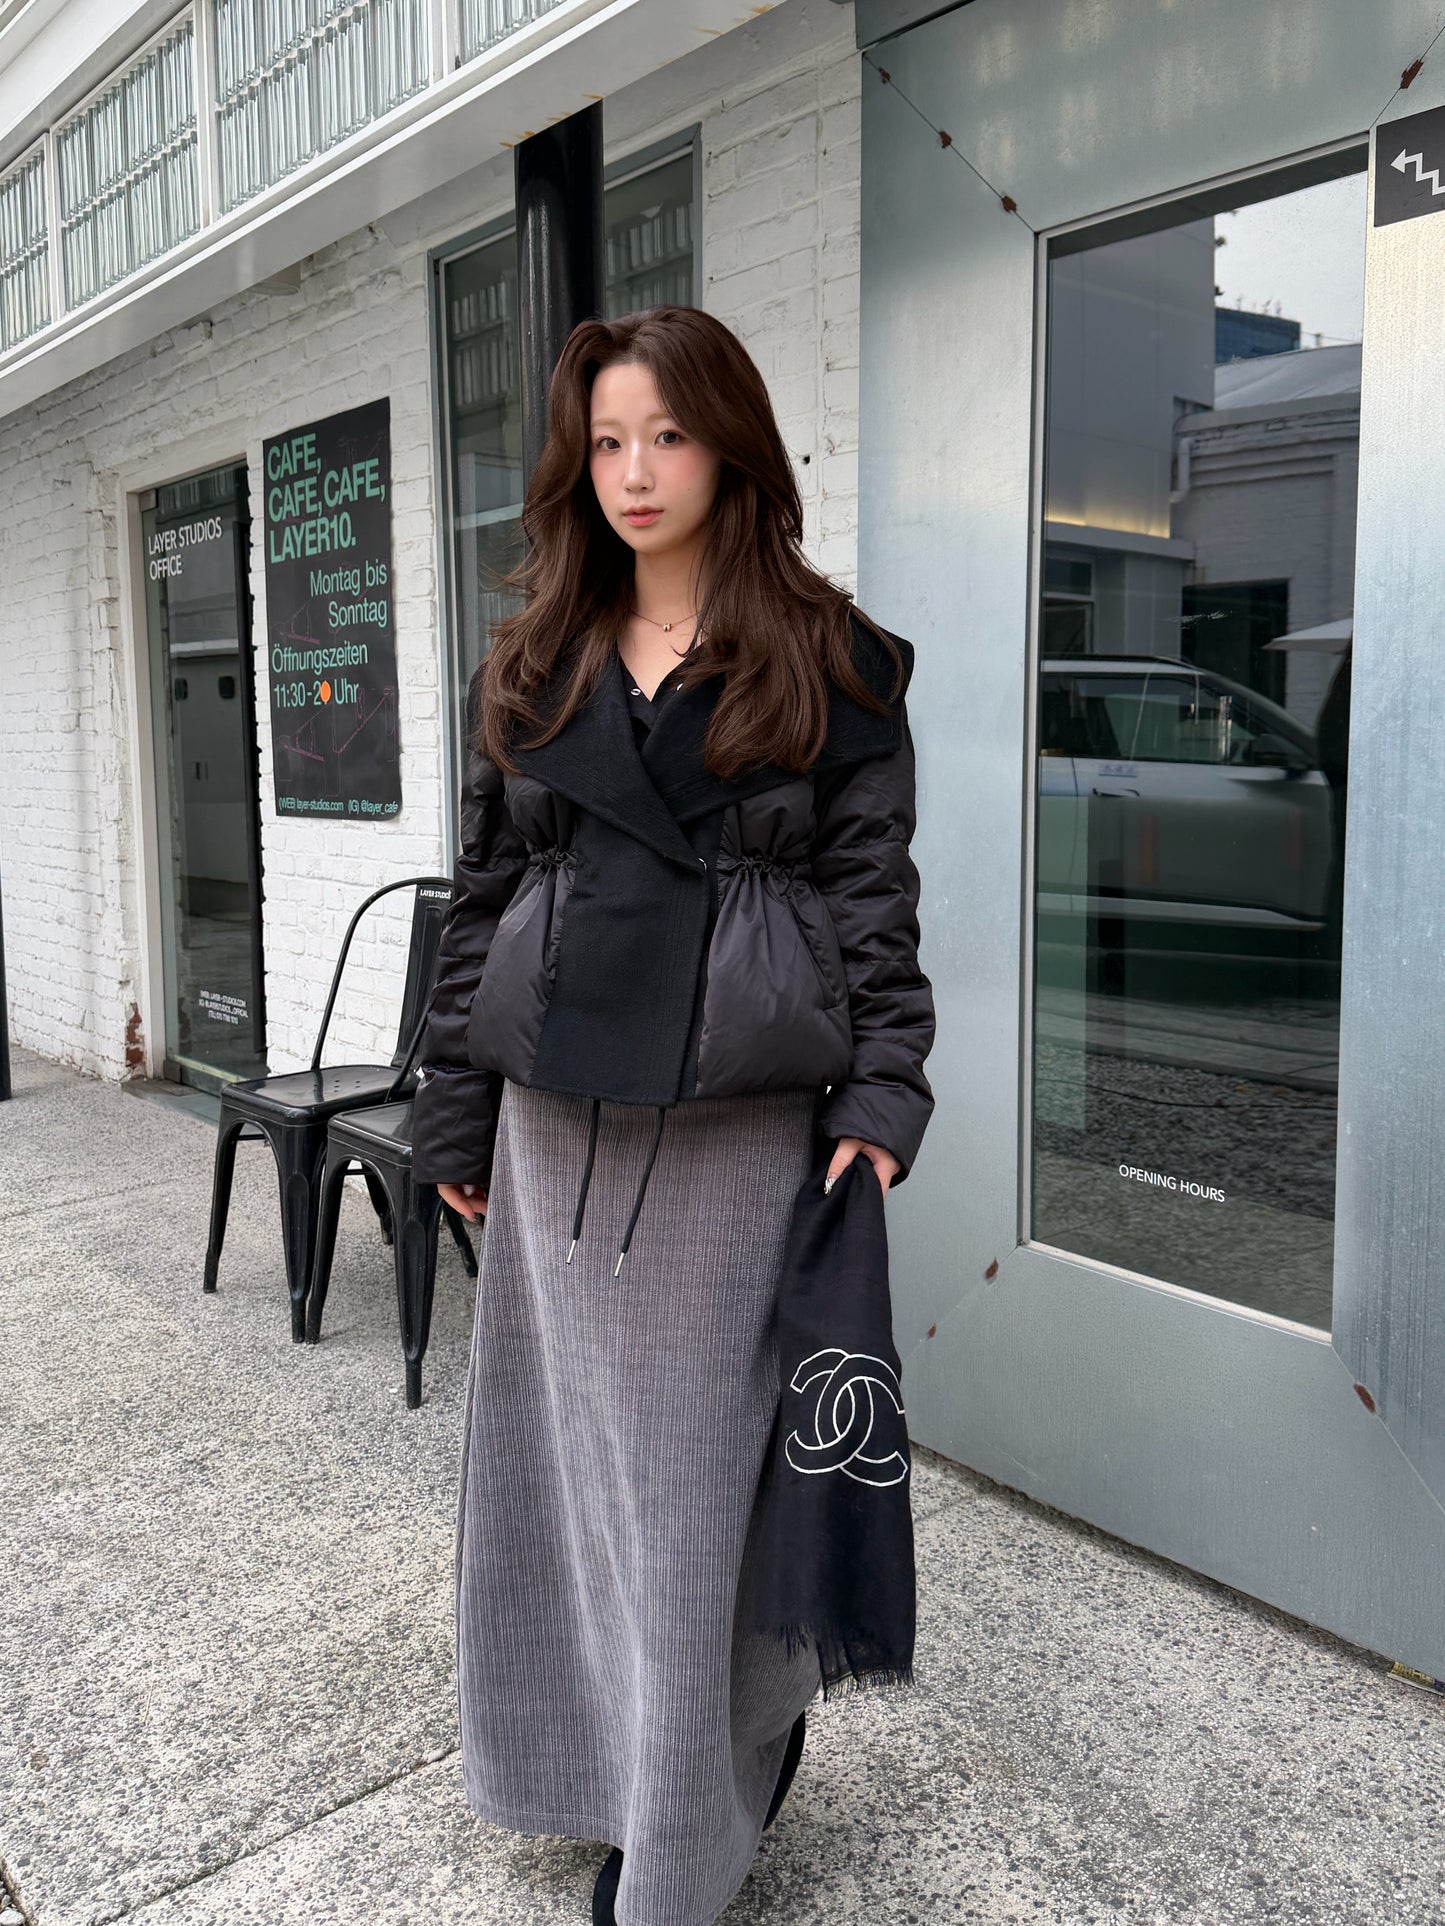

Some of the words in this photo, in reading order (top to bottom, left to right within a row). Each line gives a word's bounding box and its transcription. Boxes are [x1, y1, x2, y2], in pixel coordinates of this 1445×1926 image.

[267, 432, 322, 482] CAFE,
[268, 475, 323, 524] CAFE,
[323, 457, 386, 508] CAFE,
[148, 529, 178, 556] LAYER
[178, 516, 222, 548] STUDIOS
[269, 511, 357, 564] LAYER10.
[149, 553, 183, 581] OFFICE
[309, 567, 360, 598] Montag
[365, 558, 388, 588] bis
[328, 598, 388, 629] Sonntag
[271, 640, 368, 677] Öffnungszeiten
[273, 680, 331, 708] 11:30-2
[333, 677, 360, 705] Uhr
[1118, 1163, 1177, 1191] OPENING
[1180, 1178, 1226, 1203] HOURS
